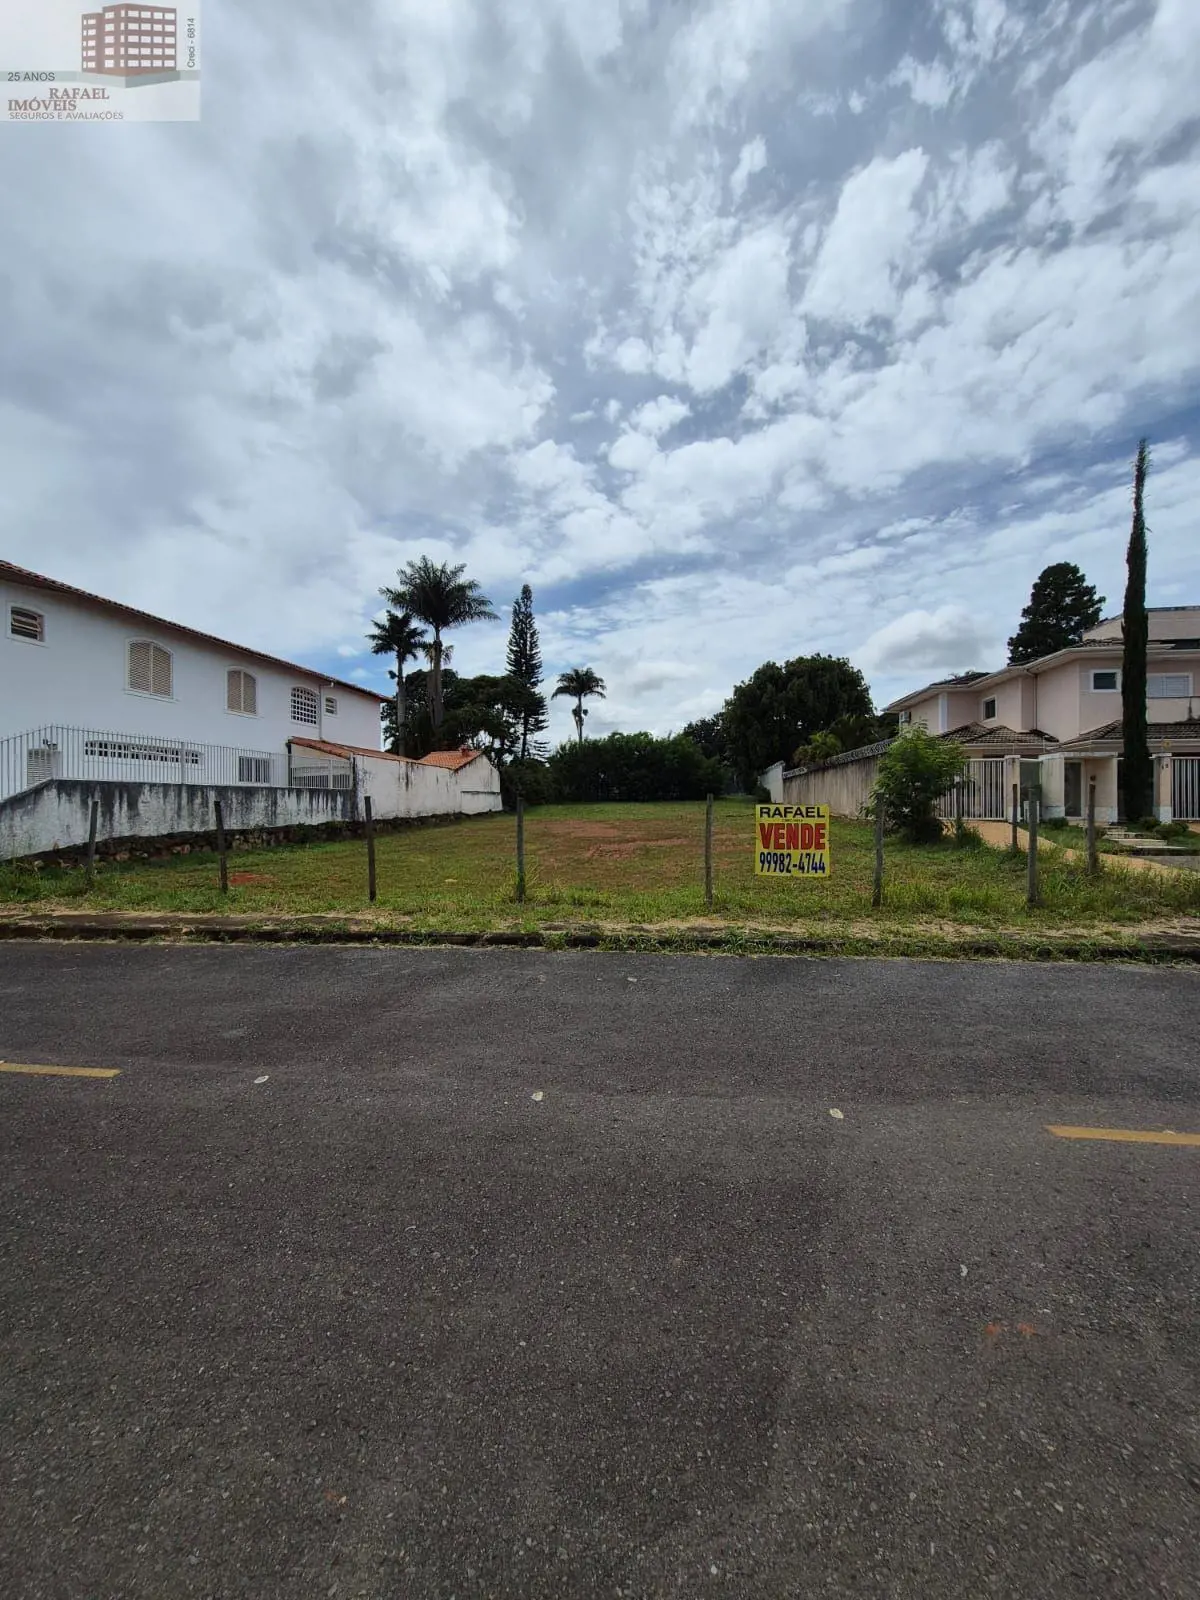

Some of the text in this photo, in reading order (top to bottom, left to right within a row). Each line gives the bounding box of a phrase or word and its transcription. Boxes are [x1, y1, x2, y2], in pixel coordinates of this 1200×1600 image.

[760, 807, 826, 818] RAFAEL
[759, 823, 826, 850] VENDE
[760, 852, 826, 874] 99982-4744
